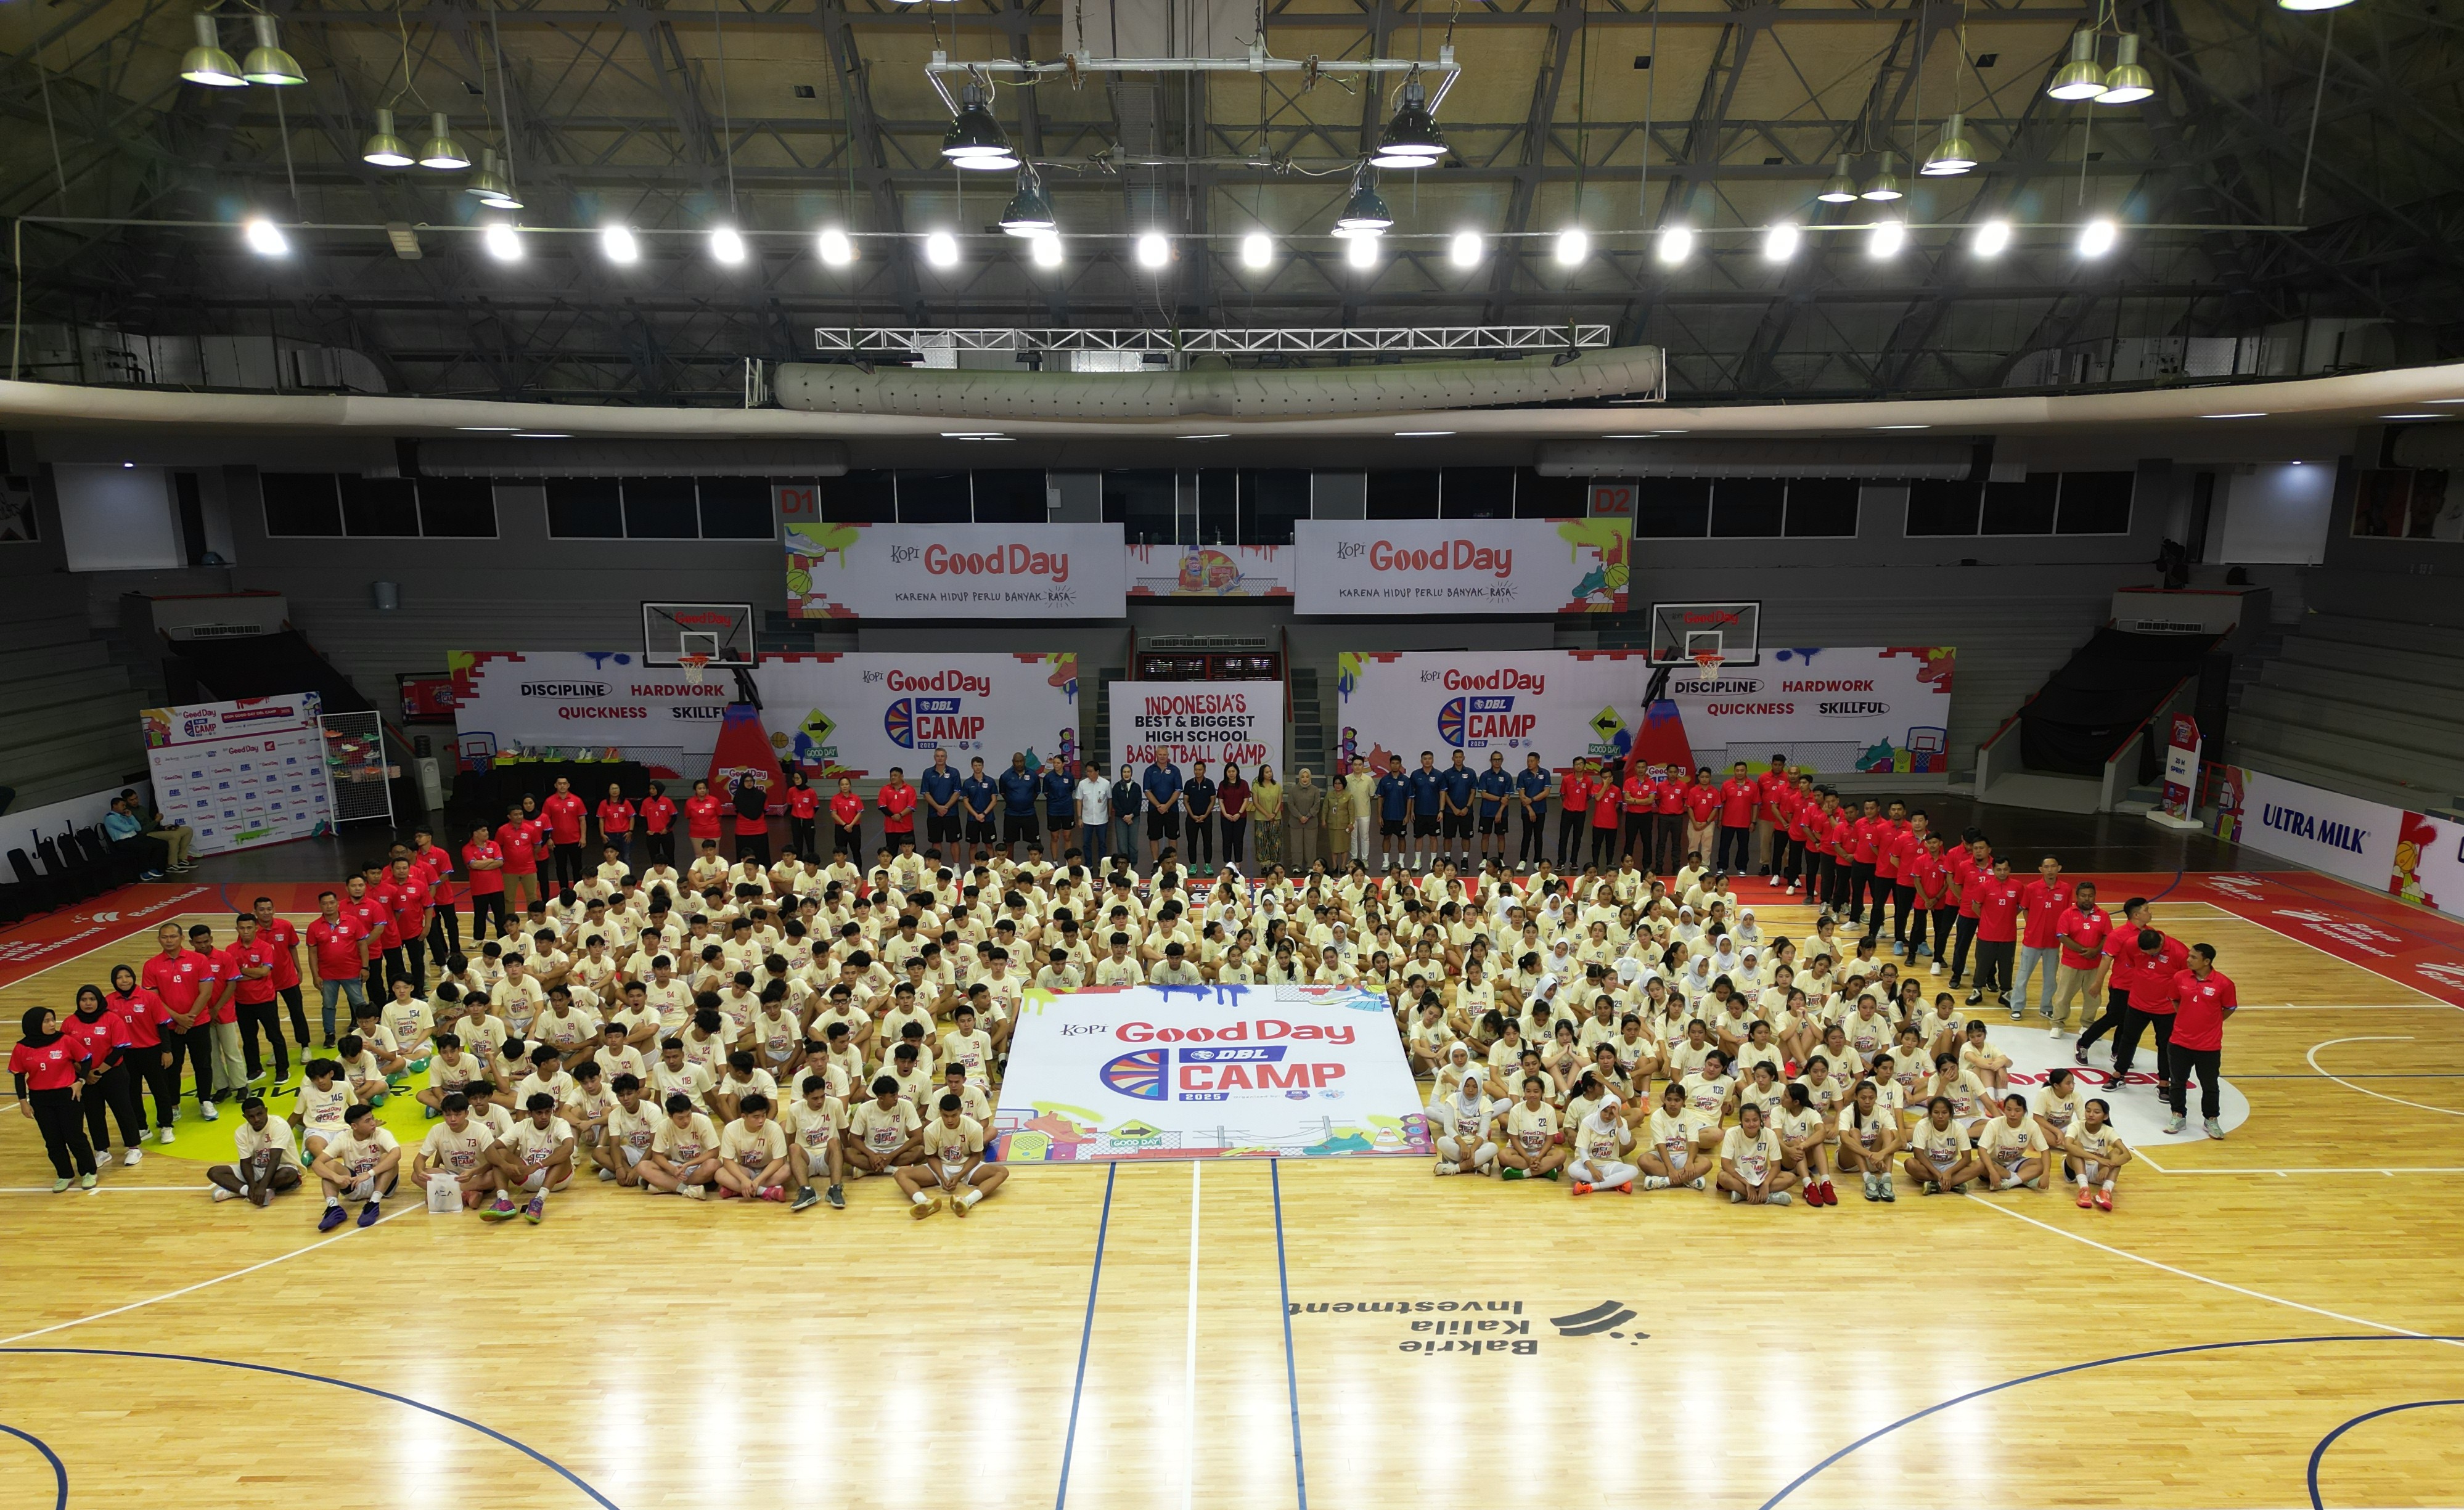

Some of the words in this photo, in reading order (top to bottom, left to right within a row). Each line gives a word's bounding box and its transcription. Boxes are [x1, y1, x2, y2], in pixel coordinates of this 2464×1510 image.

[780, 489, 813, 513] D1
[1595, 489, 1631, 512] D2
[895, 592, 937, 601] KARENA
[941, 592, 968, 601] HIDUP
[973, 592, 1001, 601] PERLU
[1005, 592, 1041, 602] BANYAK
[1049, 592, 1070, 602] RASA
[1340, 589, 1380, 597] KARENA
[1384, 589, 1412, 597] HIDUP
[1415, 589, 1443, 597] PERLU
[1447, 588, 1483, 597] BANYAK
[1490, 588, 1512, 597] RASA
[521, 684, 605, 696] DISCIPLINE
[631, 684, 726, 696] HARDWORK
[1675, 680, 1757, 693] DISCIPLINE
[1782, 680, 1874, 692] HARDWORK
[931, 701, 954, 711] DBL
[1145, 693, 1246, 716] INDONESIA'S
[1485, 699, 1507, 709] DBL
[1708, 703, 1795, 716] QUICKNESS
[1819, 702, 1885, 714] SKILLFUL
[558, 706, 647, 720] QUICKNESS
[1135, 716, 1171, 727] BEST
[1176, 716, 1187, 727] &
[1190, 716, 1255, 727] BIGGEST
[1468, 714, 1536, 738] CAMP
[194, 724, 216, 733] CAMP
[917, 717, 984, 740] CAMP
[1145, 730, 1184, 742] HIGH
[1187, 730, 1250, 742] SCHOOL
[806, 749, 822, 757] GOOD
[824, 748, 837, 757] DAY
[1223, 742, 1266, 765] CAMP
[1590, 745, 1606, 754] GOOD
[1607, 746, 1620, 754] DAY
[2263, 803, 2314, 840] ULTRA
[2317, 820, 2367, 854] MILK
[128, 887, 210, 917] Bakrieland
[9, 926, 107, 961] Investment
[330, 936, 338, 944] 31
[2302, 923, 2396, 957] Investment
[2148, 961, 2156, 969] 22
[173, 974, 182, 983] 49
[1115, 1021, 1251, 1043] Good
[1256, 1019, 1356, 1045] Day
[972, 1040, 980, 1048] 39
[1215, 1048, 1270, 1061] DBL
[40, 1062, 47, 1071] 9
[1915, 1061, 1920, 1069] 2
[682, 1076, 692, 1085] 118
[1179, 1063, 1346, 1090] CAMP
[908, 1084, 917, 1093] 31
[1960, 1084, 1969, 1093] 112
[331, 1093, 343, 1102] 146
[1769, 1096, 1780, 1106] 125
[965, 1100, 974, 1108] 79
[891, 1114, 900, 1123] 78
[1538, 1118, 1547, 1127] 22
[486, 1121, 495, 1130] 90
[1801, 1122, 1806, 1131] 9
[467, 1138, 477, 1148] 73
[1946, 1137, 1955, 1146] 110
[2018, 1133, 2028, 1143] 99
[1757, 1142, 1766, 1151] 87
[1288, 1300, 1523, 1315] Investment
[1410, 1320, 1530, 1335] Kalila
[1399, 1340, 1538, 1356] Bakrie
